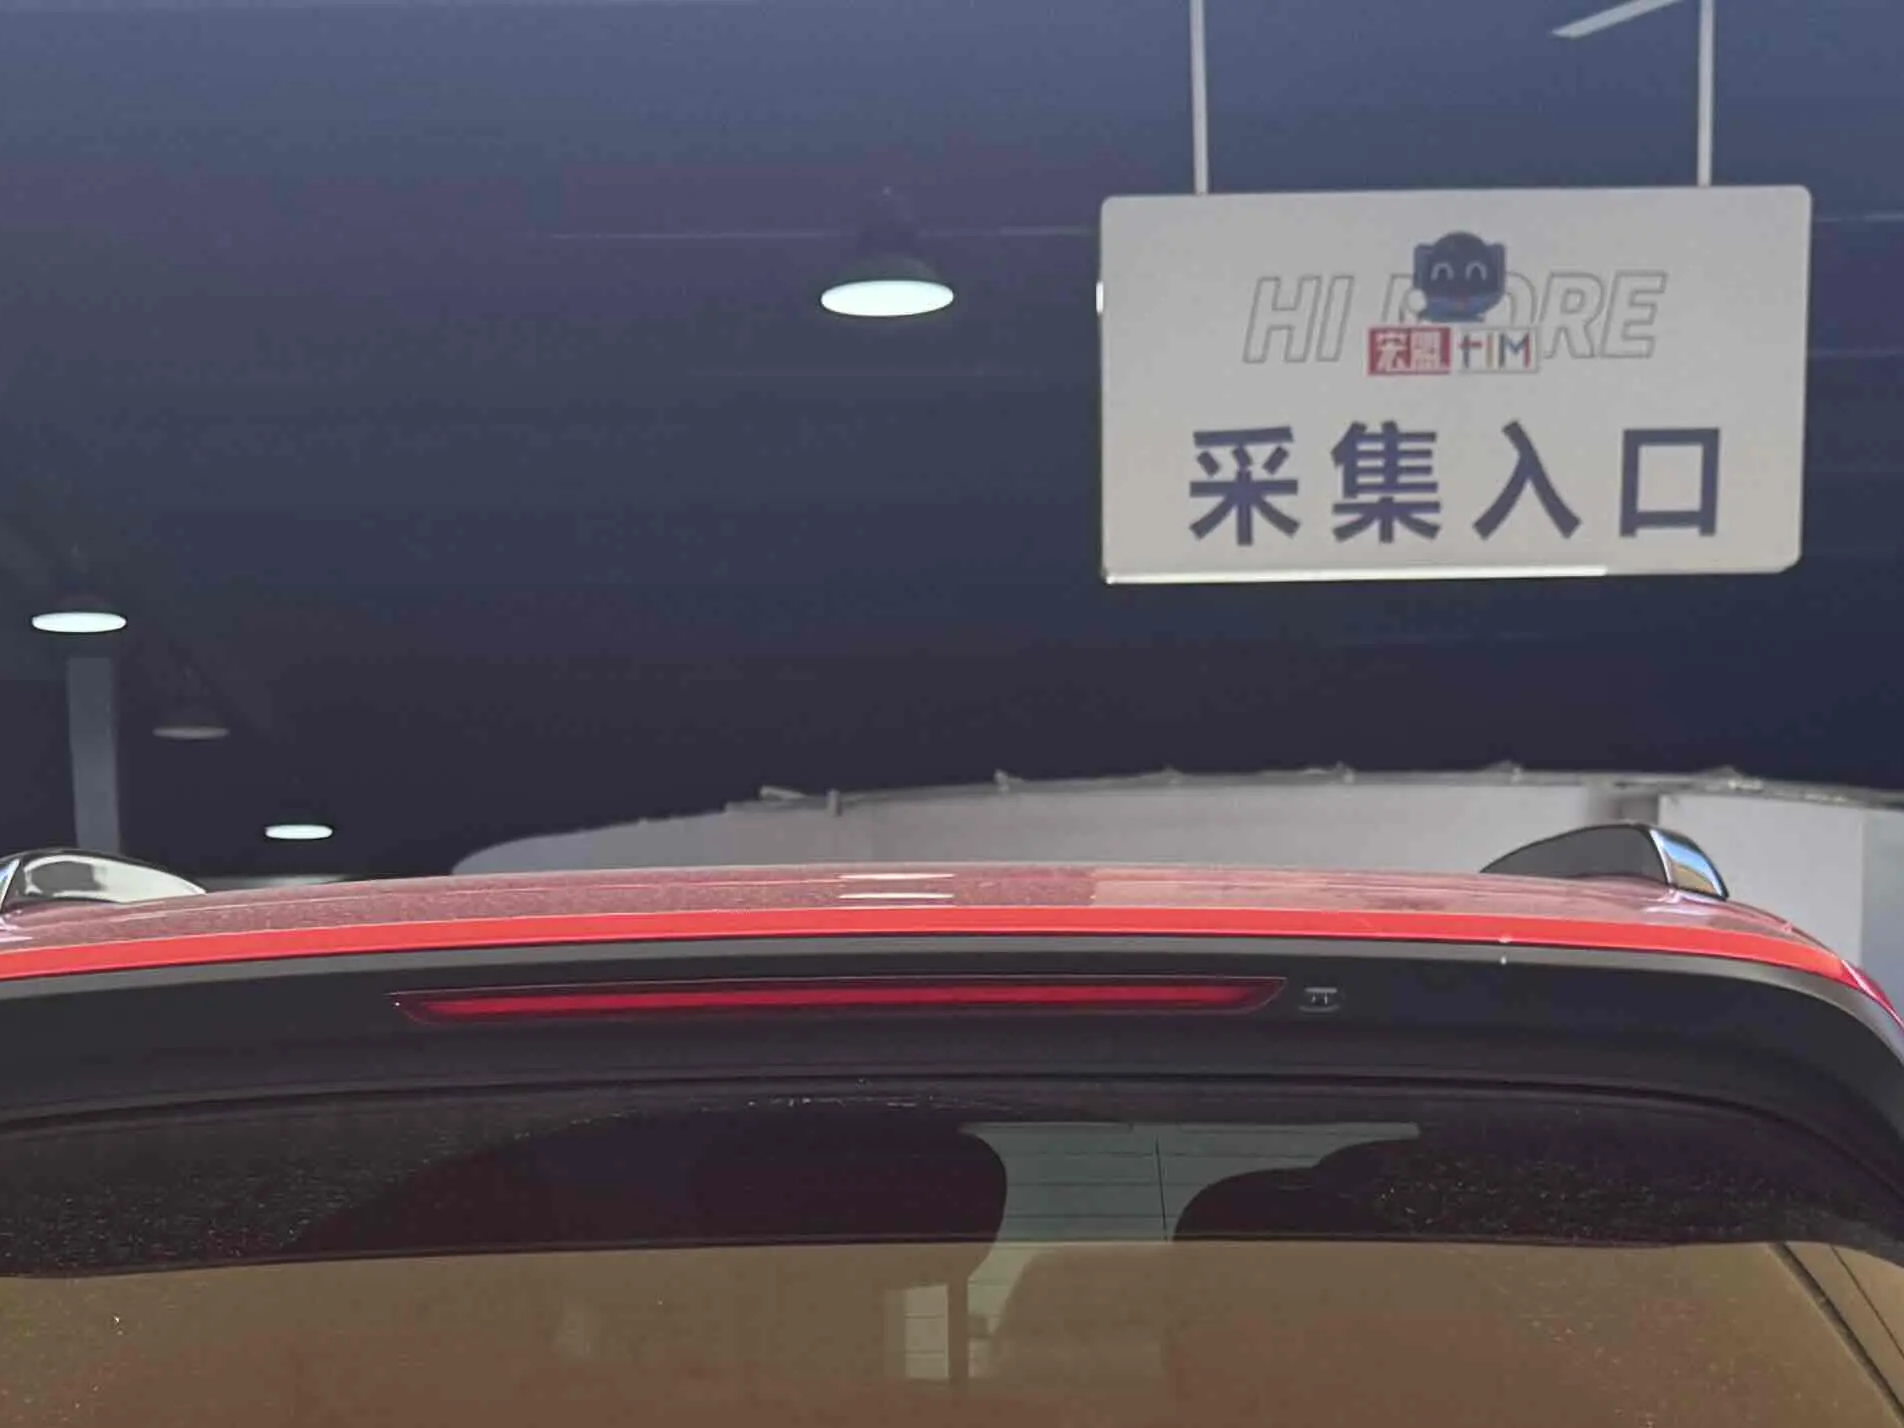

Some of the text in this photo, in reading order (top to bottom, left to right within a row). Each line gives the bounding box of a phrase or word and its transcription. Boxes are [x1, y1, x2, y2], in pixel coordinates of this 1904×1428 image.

[1241, 274, 1355, 364] HI
[1188, 420, 1722, 546] 采集入口
